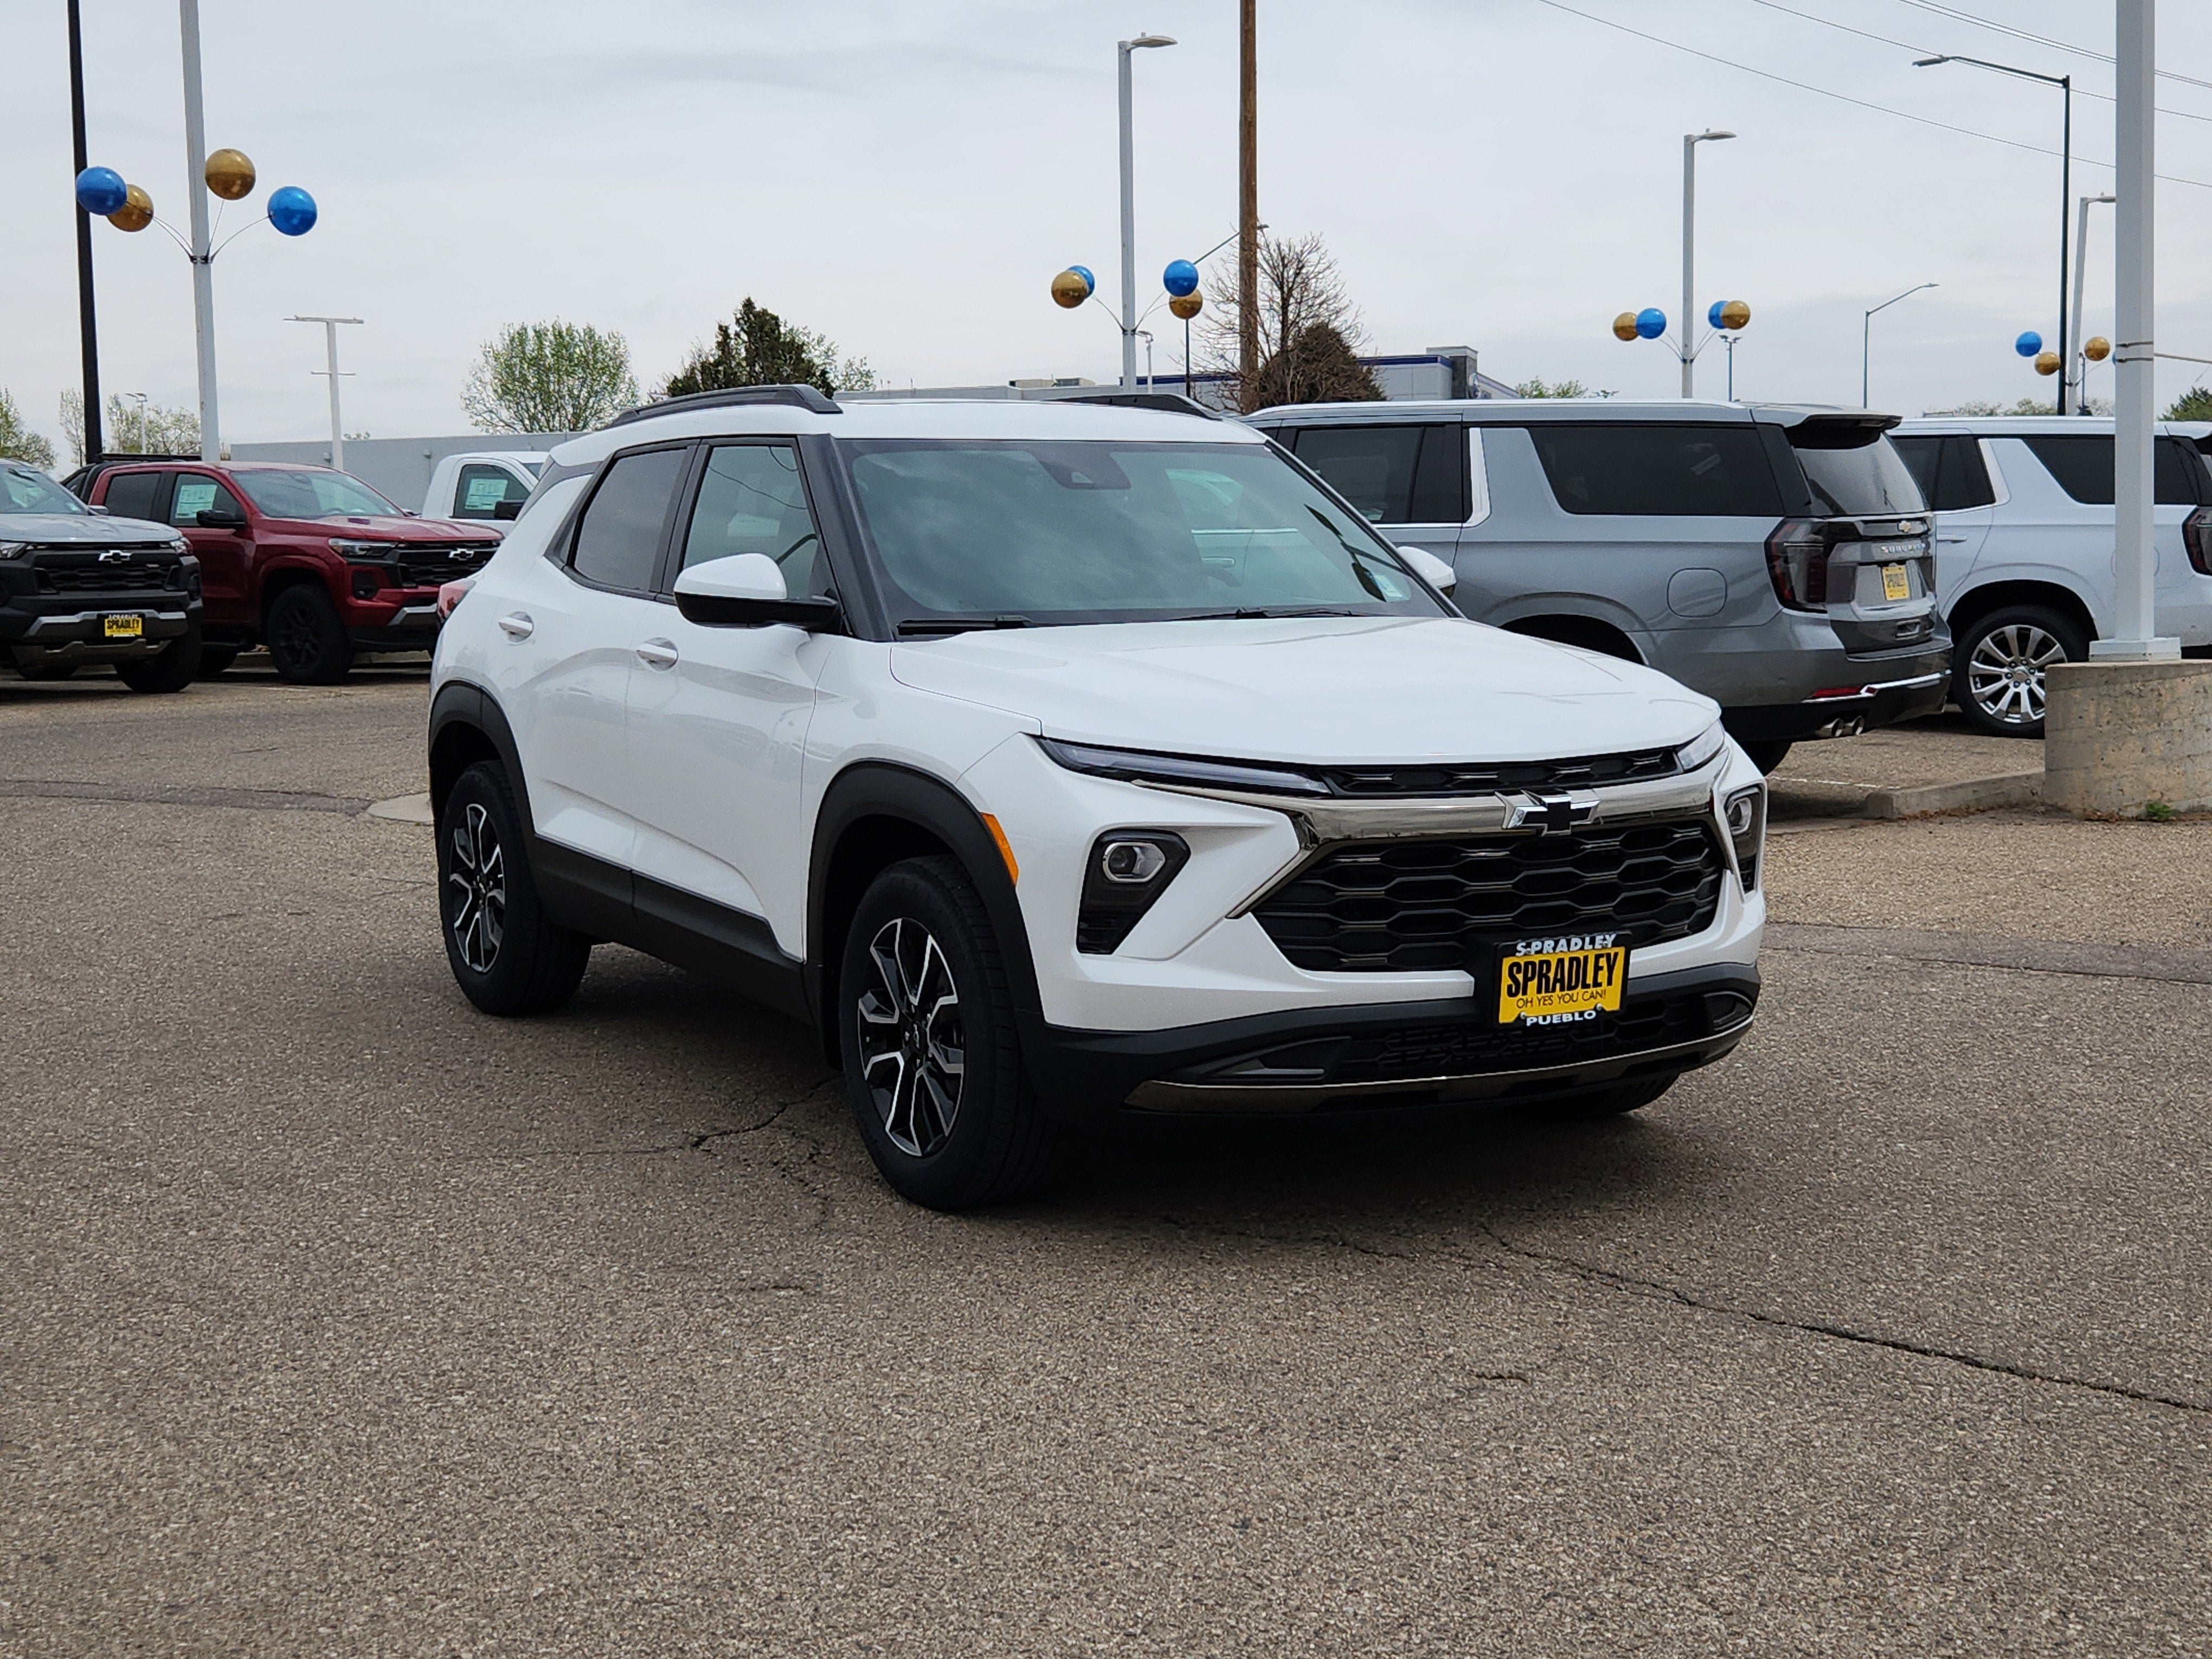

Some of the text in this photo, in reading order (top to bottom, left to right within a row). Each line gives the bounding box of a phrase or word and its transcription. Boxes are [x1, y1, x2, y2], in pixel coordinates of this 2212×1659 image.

[1515, 933, 1617, 956] SPRADLEY
[1507, 951, 1619, 998] SPRADLEY
[1516, 989, 1606, 1008] OH YES YOU CAN!
[1526, 1010, 1596, 1026] PUEBLO
